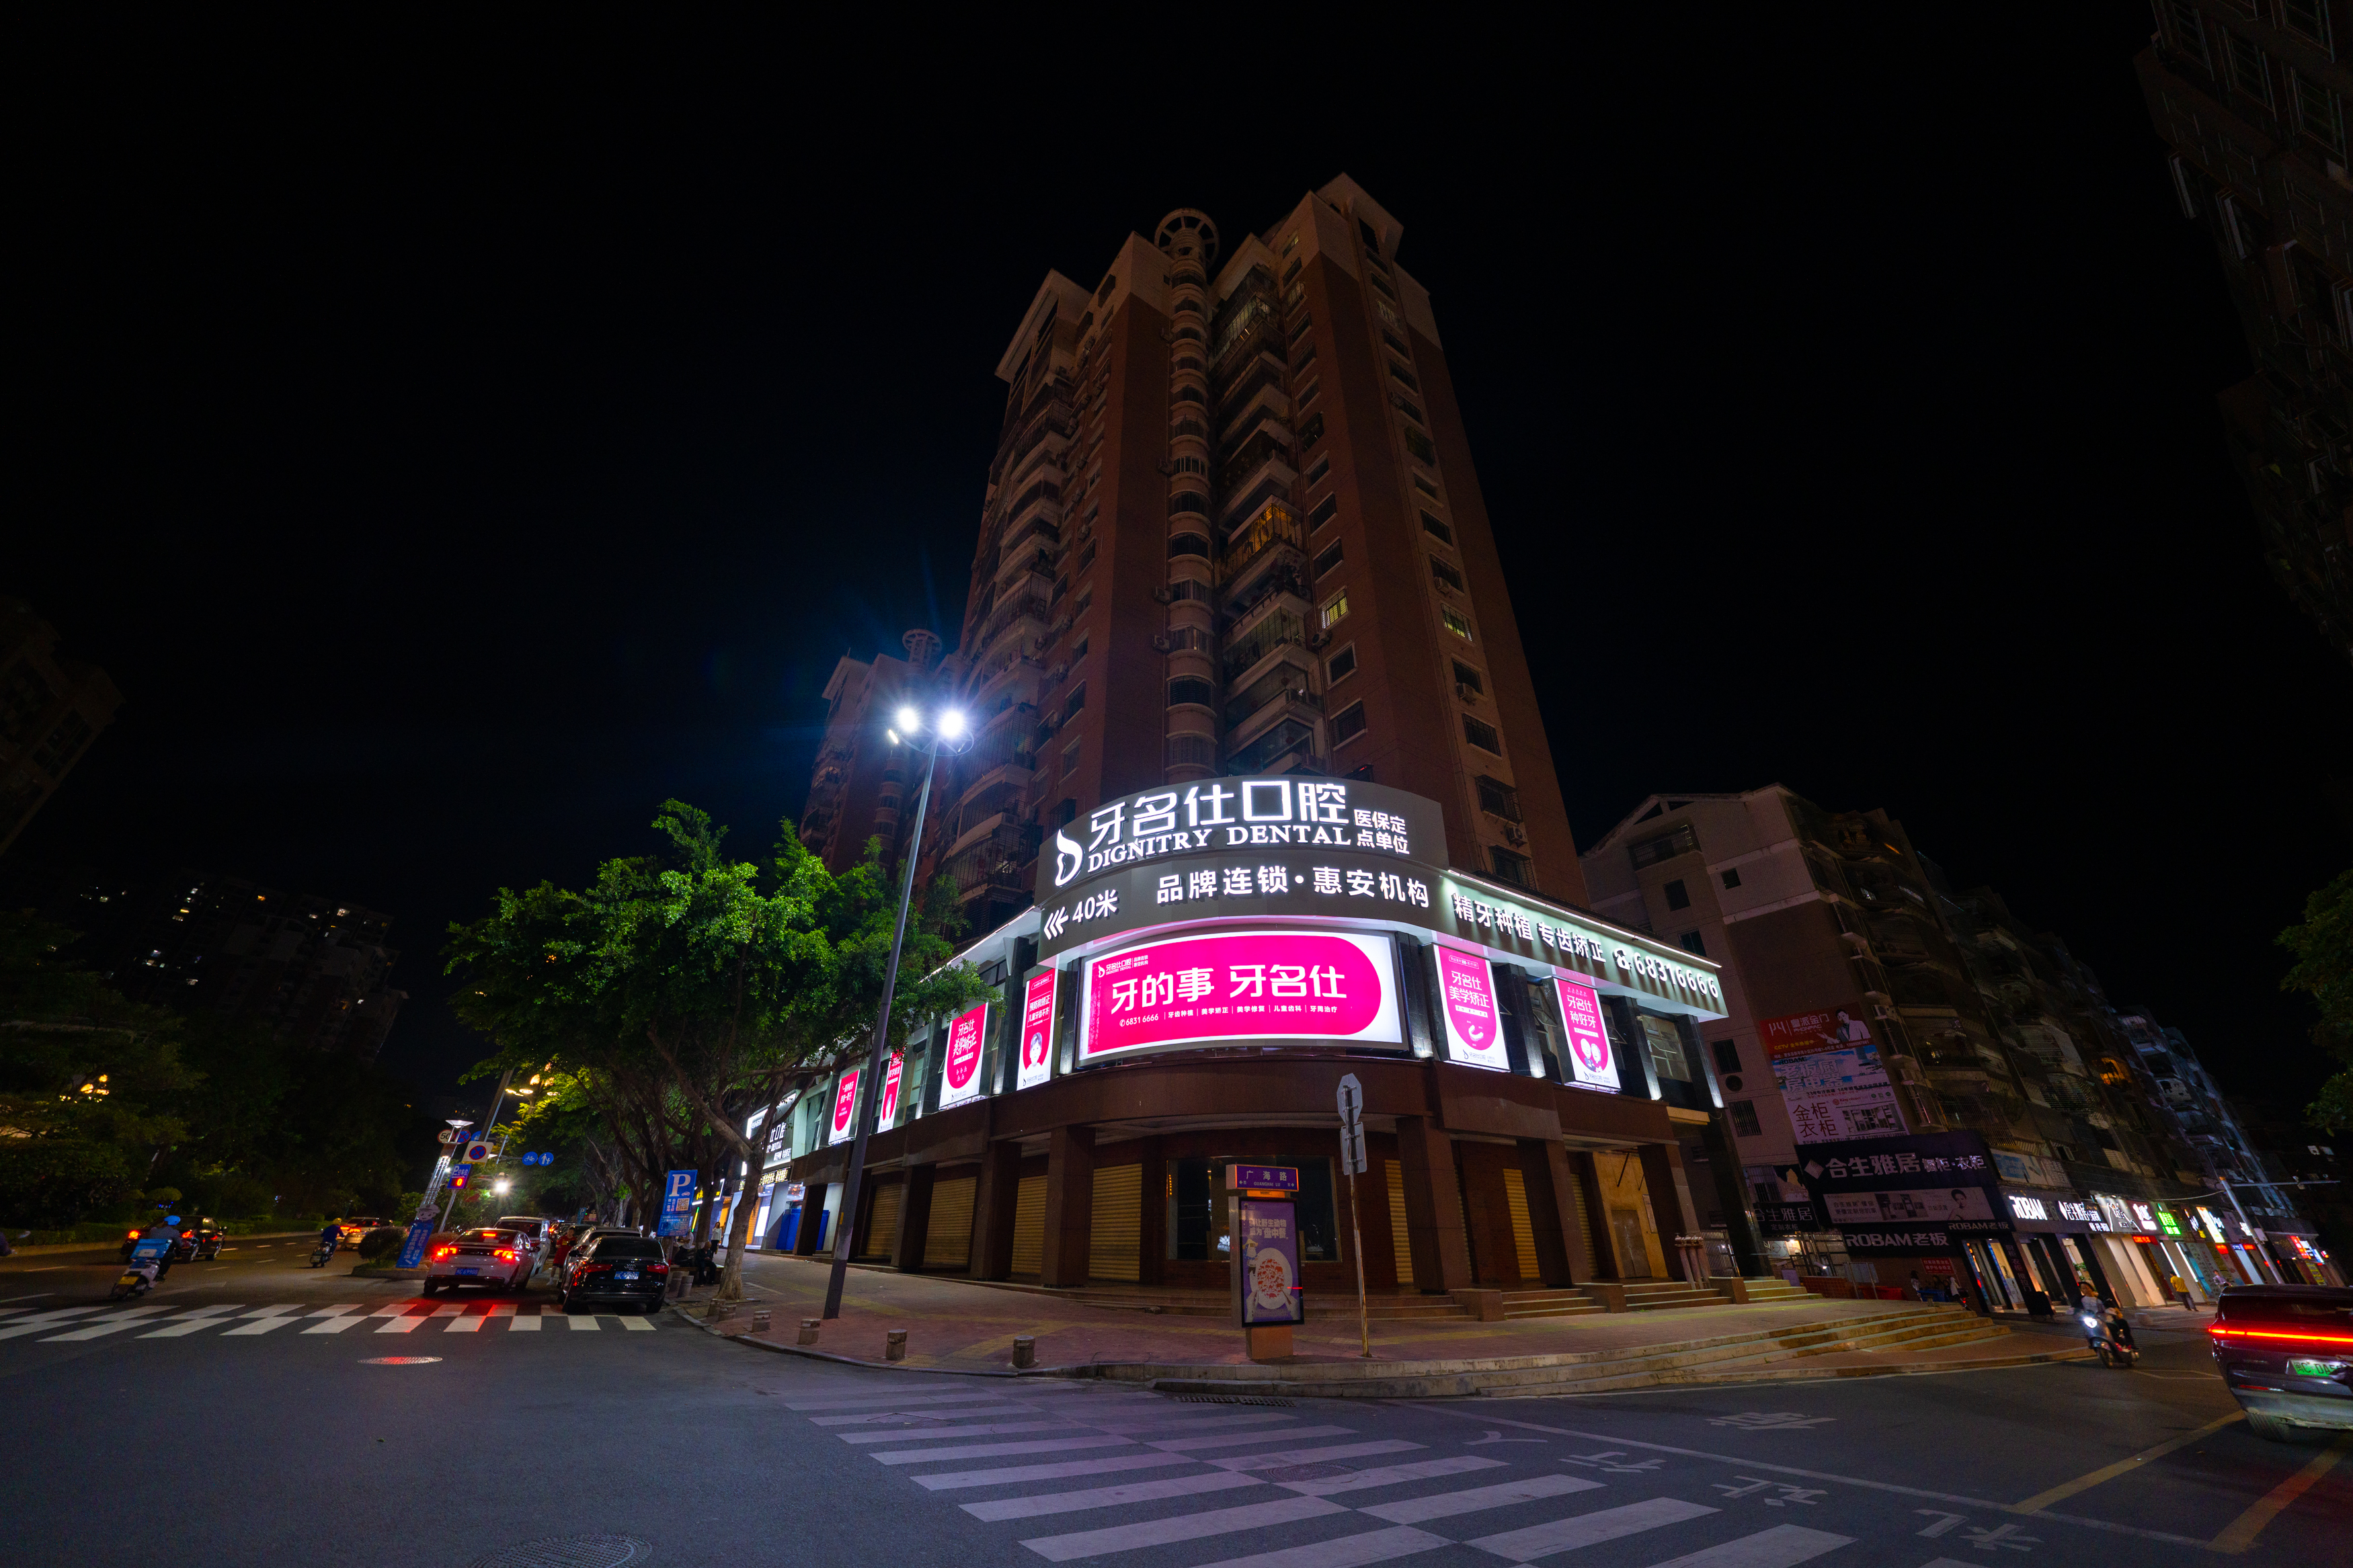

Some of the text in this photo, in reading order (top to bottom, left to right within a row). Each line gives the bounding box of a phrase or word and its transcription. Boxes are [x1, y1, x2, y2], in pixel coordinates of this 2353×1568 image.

[1088, 780, 1349, 848] 牙名仕口腔
[1354, 809, 1407, 835] 医保定
[1088, 825, 1351, 873] DIGNITRY DENTAL
[1356, 830, 1409, 855] 点单位
[1073, 889, 1119, 923] 40米
[1452, 893, 1718, 998] 精牙种植 专齿矫正 68316666
[1111, 964, 1347, 1014] 牙的事 牙名仕
[1451, 971, 1482, 991] 牙名仕
[1449, 986, 1490, 1008] 美学矫正
[1566, 995, 1594, 1013] 牙名仕
[1168, 1009, 1193, 1018] 牙齿种植
[1201, 1007, 1229, 1016] 美学矫正
[1570, 1011, 1596, 1028] 种好牙
[957, 1019, 975, 1036] 牙名仕
[1793, 1102, 1831, 1122] 金柜
[1798, 1120, 1839, 1138] 衣柜
[1246, 1170, 1287, 1181] 广海路
[1826, 1153, 1921, 1178] 合生雅居
[669, 1174, 690, 1196] P
[1755, 1207, 1812, 1222] 合生雅居
